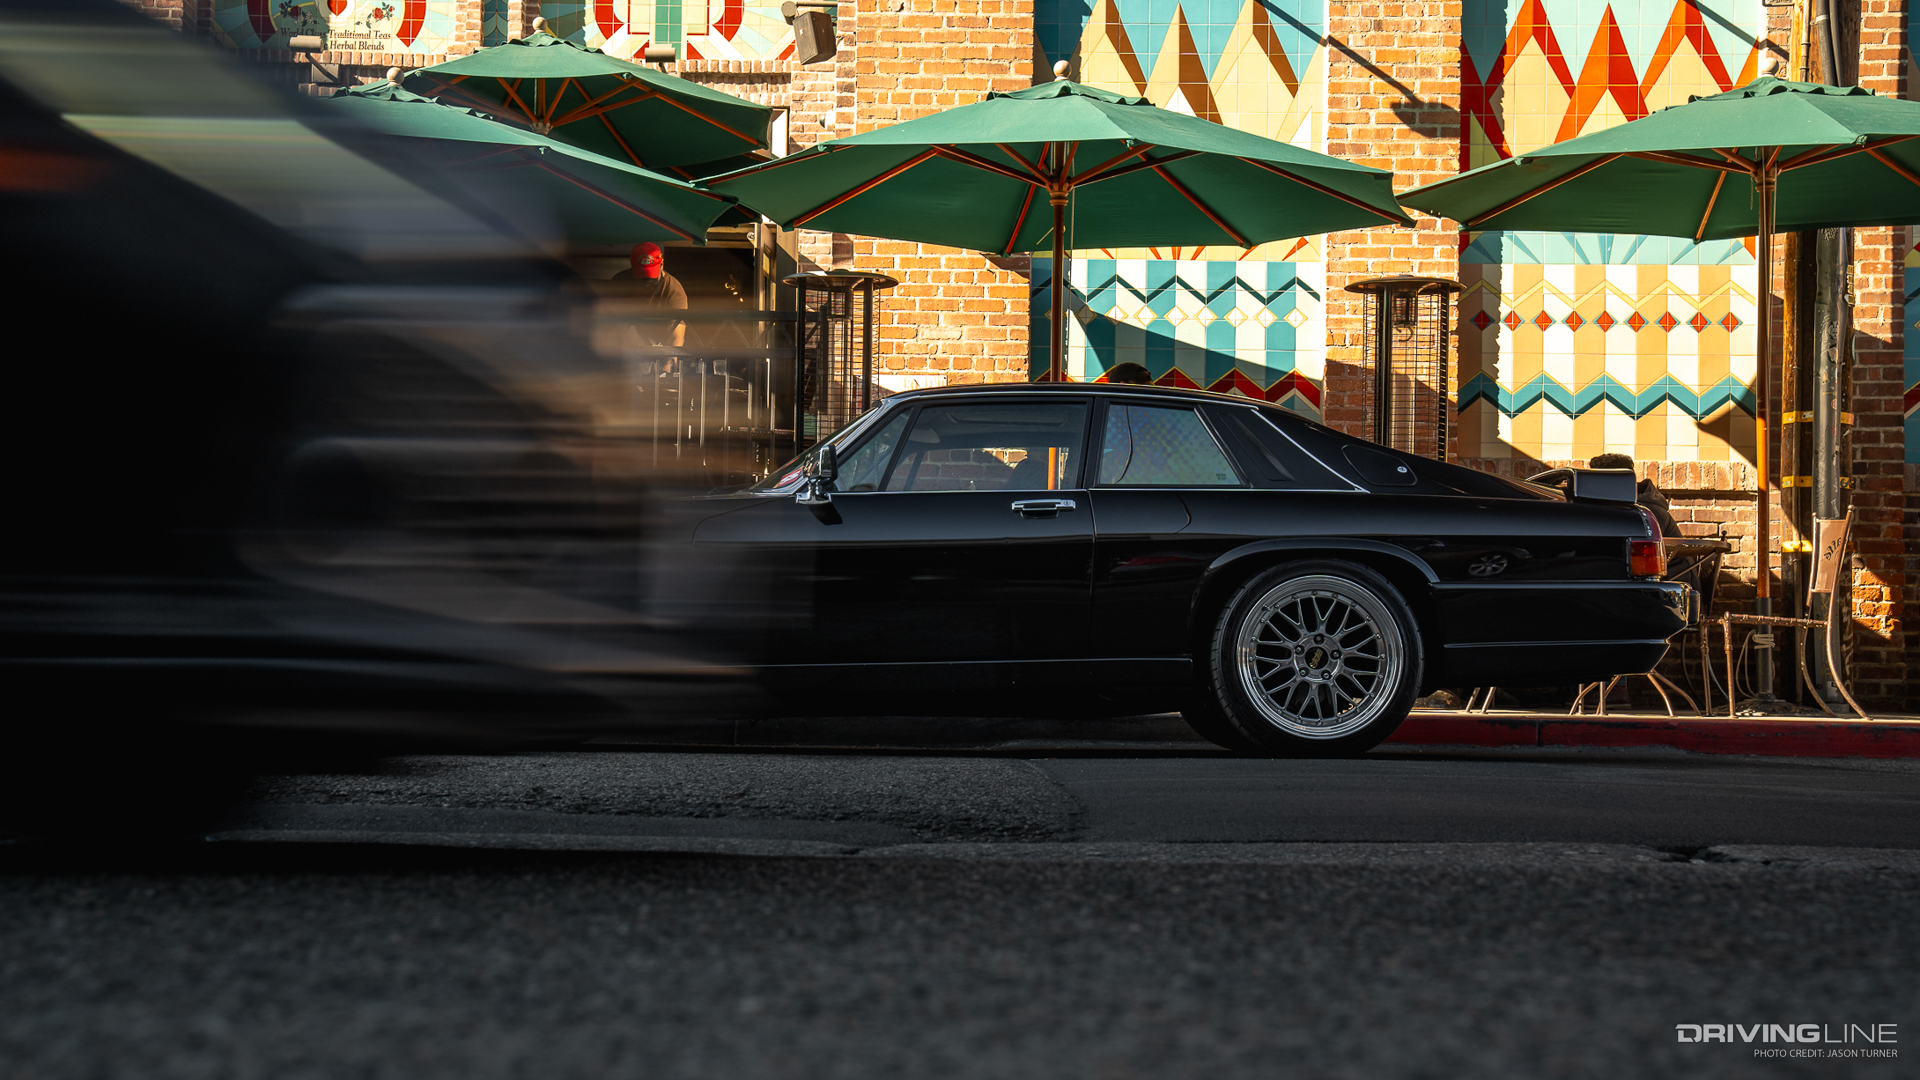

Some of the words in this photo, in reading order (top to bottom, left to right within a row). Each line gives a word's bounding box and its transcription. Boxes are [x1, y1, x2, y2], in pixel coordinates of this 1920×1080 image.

[281, 28, 304, 38] World
[329, 29, 372, 39] Traditional
[374, 30, 391, 39] Teas
[330, 40, 357, 50] Herbal
[358, 40, 385, 50] Blends
